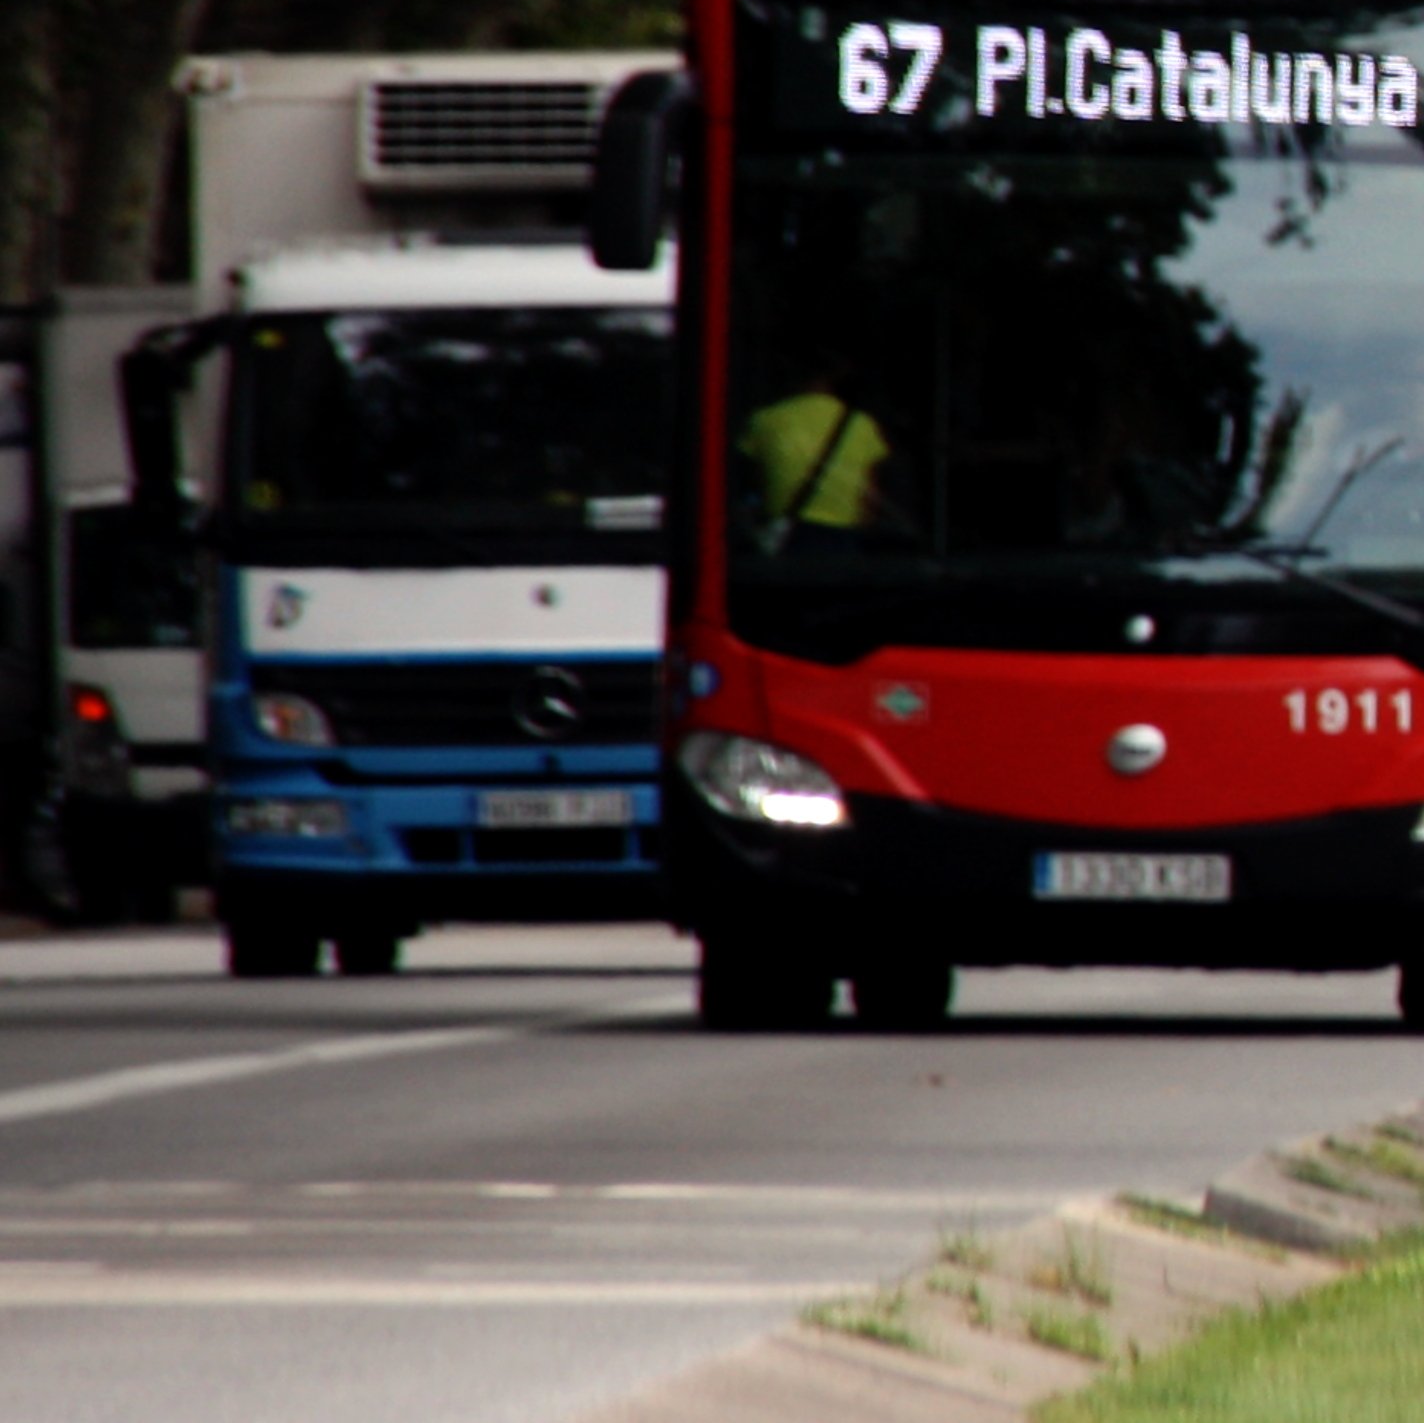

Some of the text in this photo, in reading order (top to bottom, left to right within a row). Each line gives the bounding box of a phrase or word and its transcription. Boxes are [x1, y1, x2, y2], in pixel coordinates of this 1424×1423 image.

[838, 22, 1418, 127] 67 Pl.Catalunya
[1283, 686, 1412, 735] 1911
